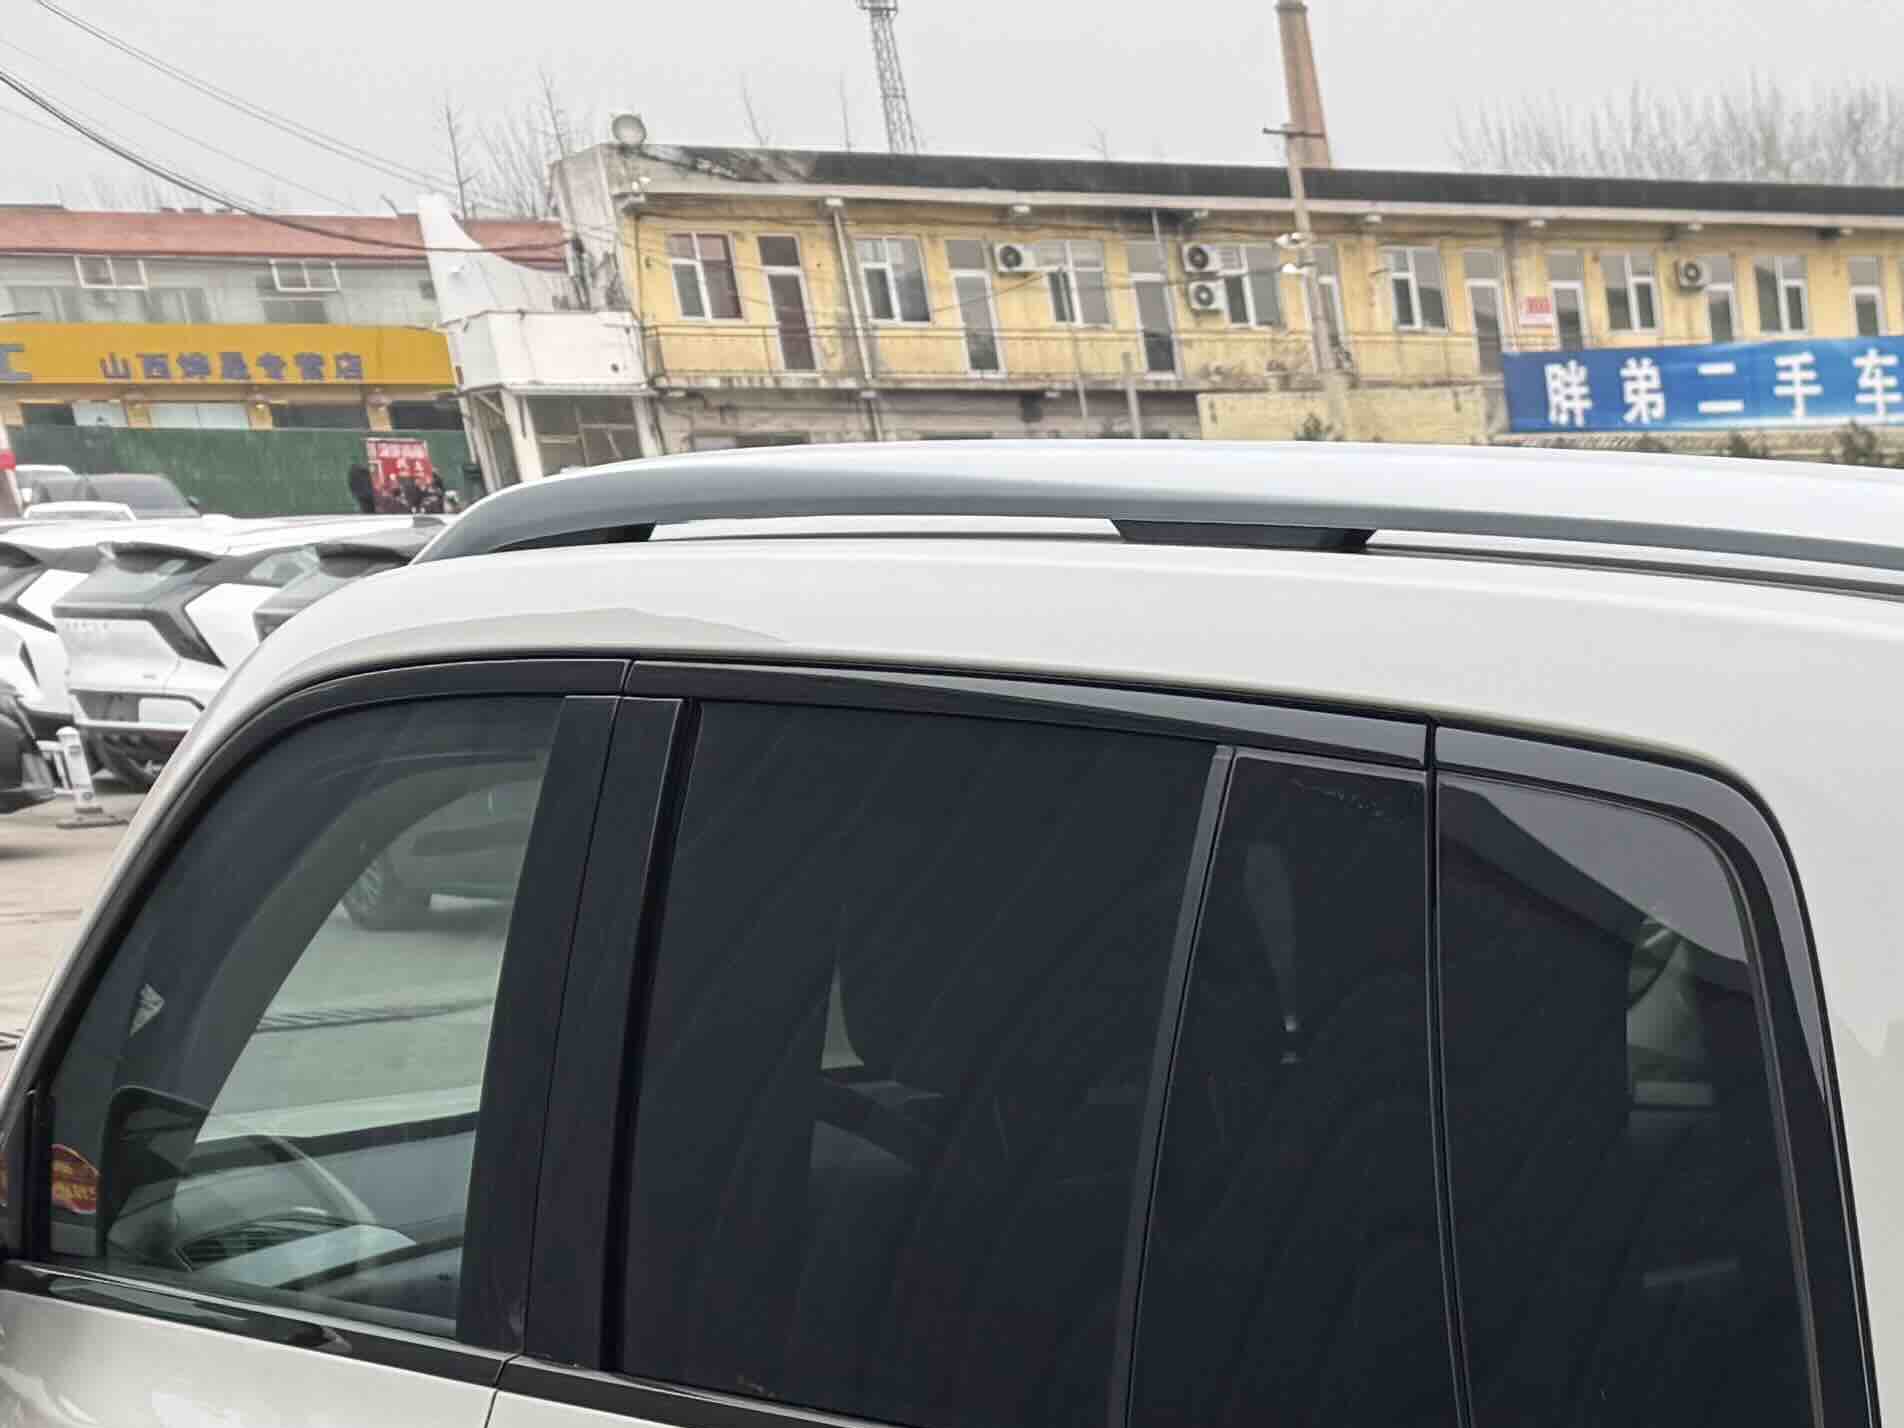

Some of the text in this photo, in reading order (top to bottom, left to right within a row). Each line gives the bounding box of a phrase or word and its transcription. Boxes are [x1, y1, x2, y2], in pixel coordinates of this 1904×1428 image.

[1543, 348, 1904, 427] 胖弟二手车
